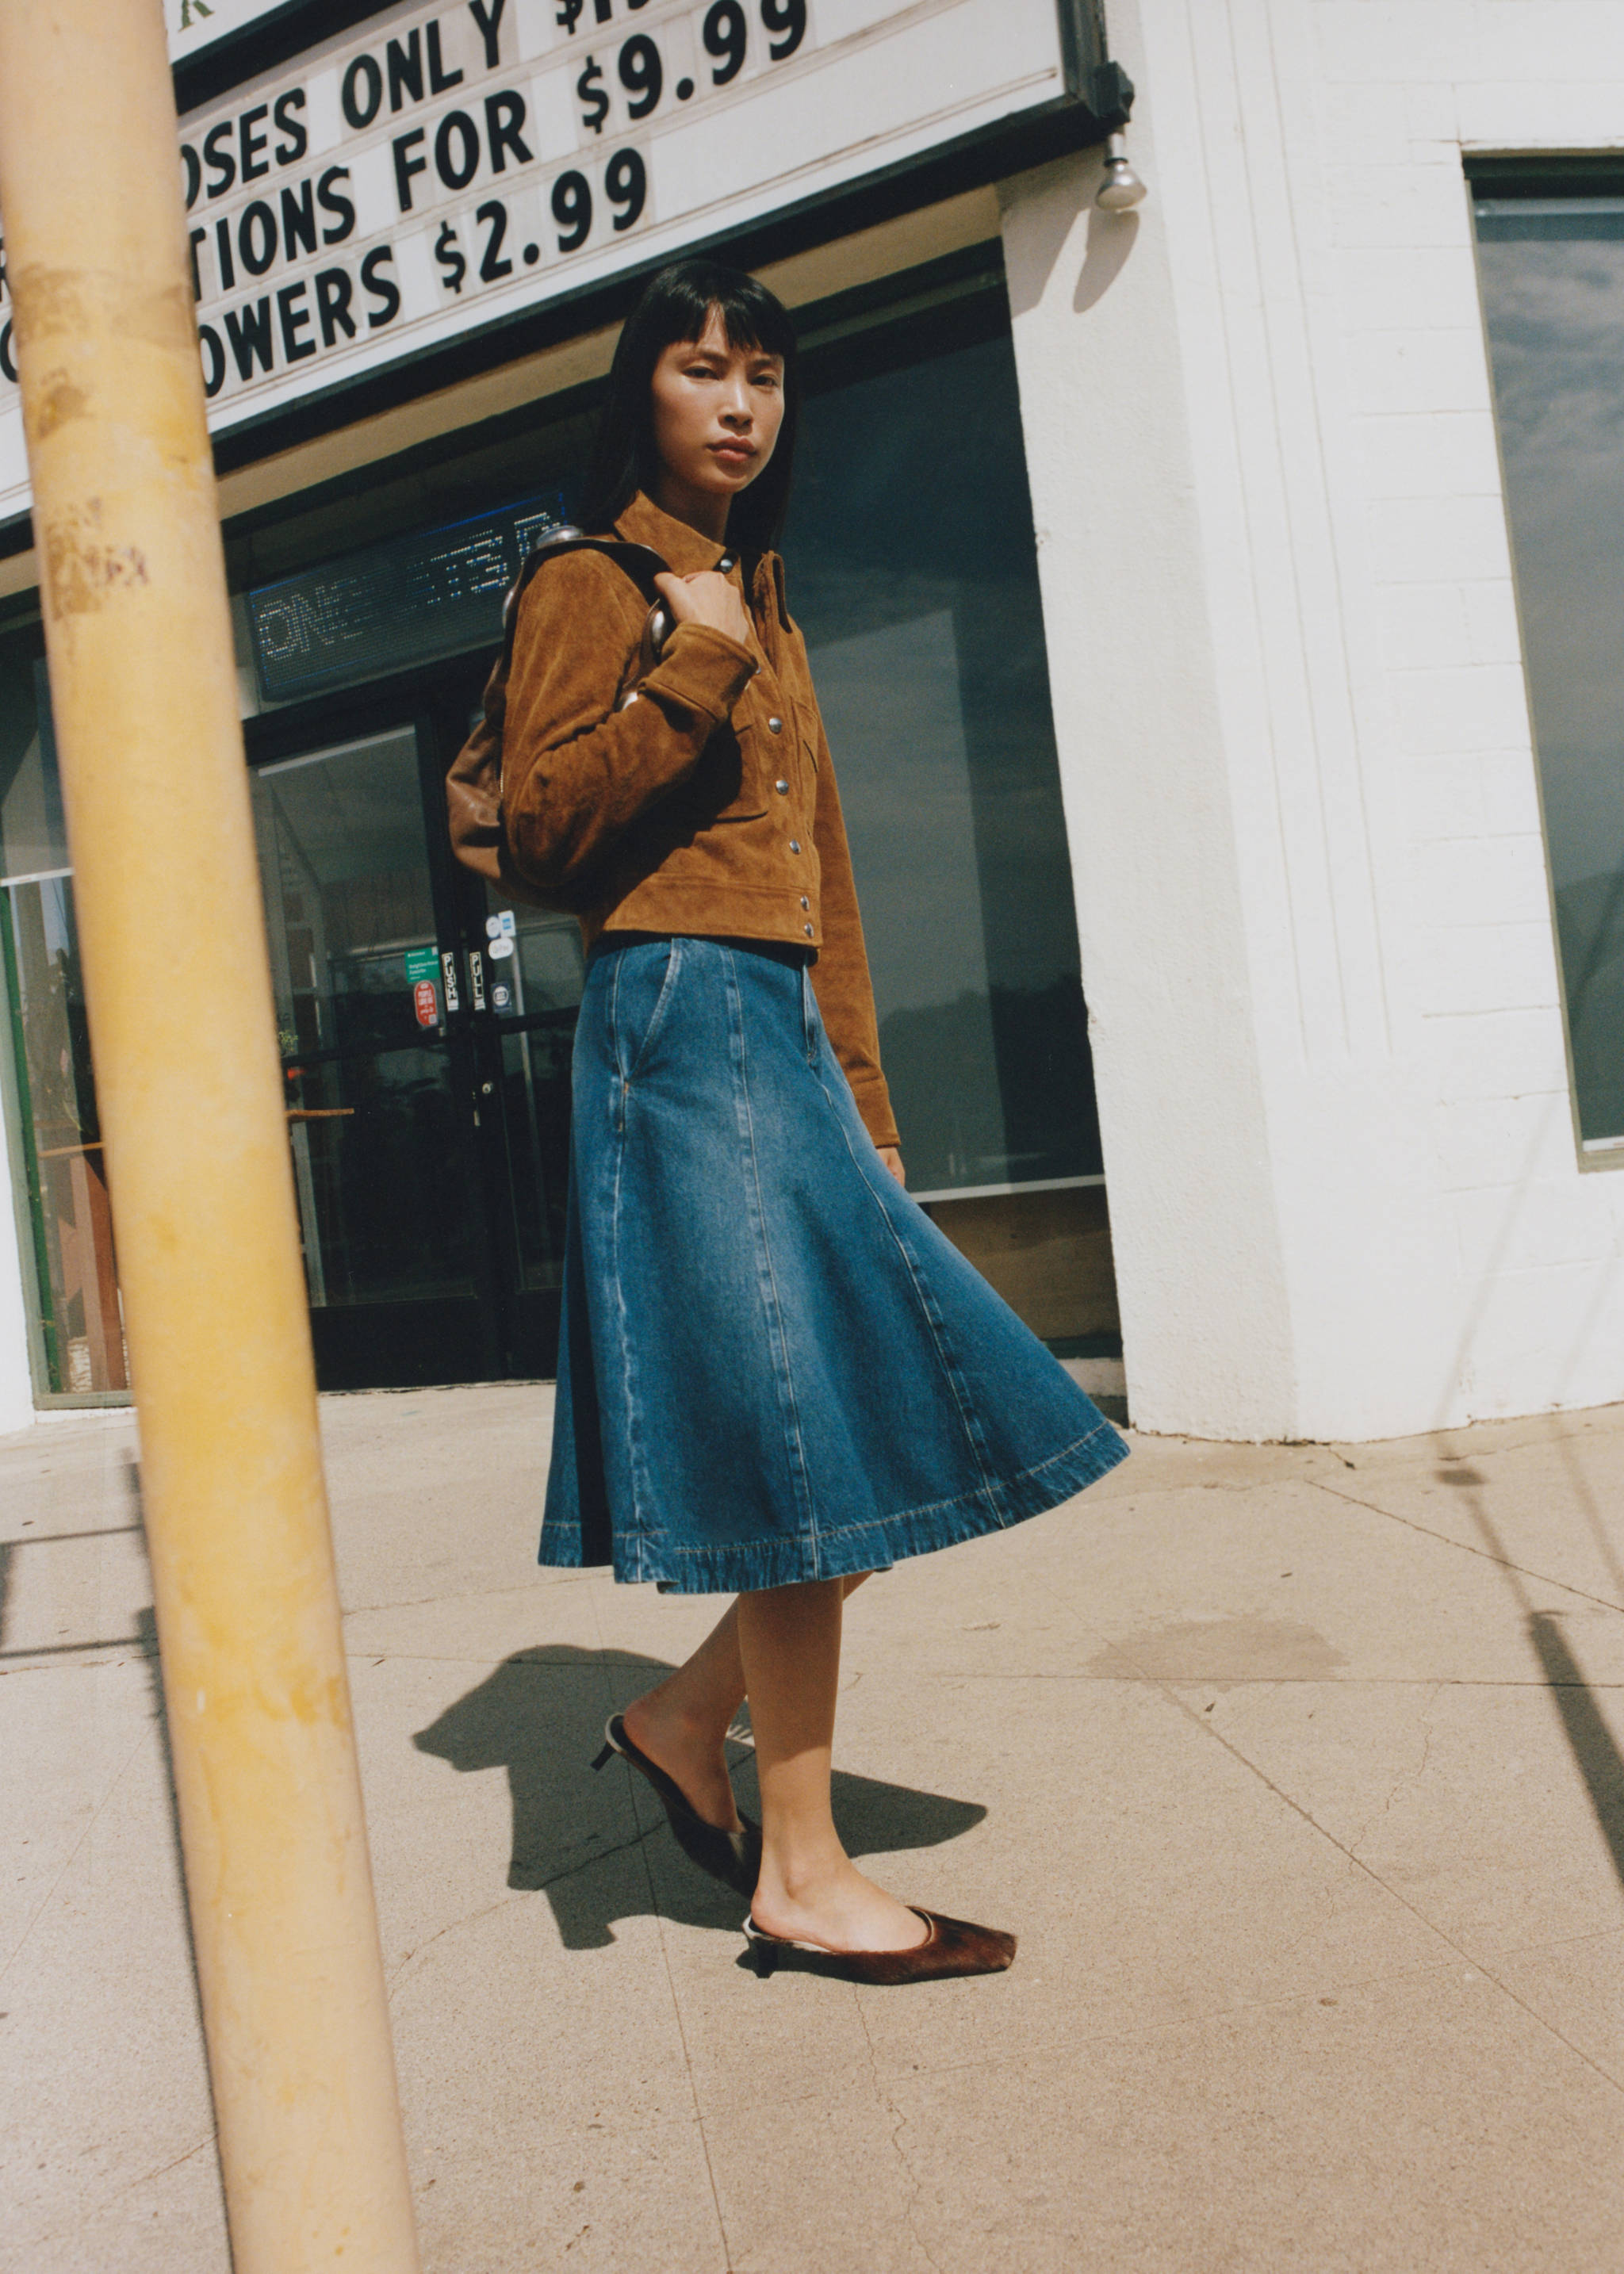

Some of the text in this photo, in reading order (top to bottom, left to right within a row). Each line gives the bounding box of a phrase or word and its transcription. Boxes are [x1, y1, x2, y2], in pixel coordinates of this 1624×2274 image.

[341, 0, 506, 130] ONLY
[392, 90, 534, 213] FOR
[576, 0, 807, 135] $9.99
[435, 147, 647, 294] $2.99
[444, 955, 458, 999] PUSH
[472, 955, 482, 997] PULL
